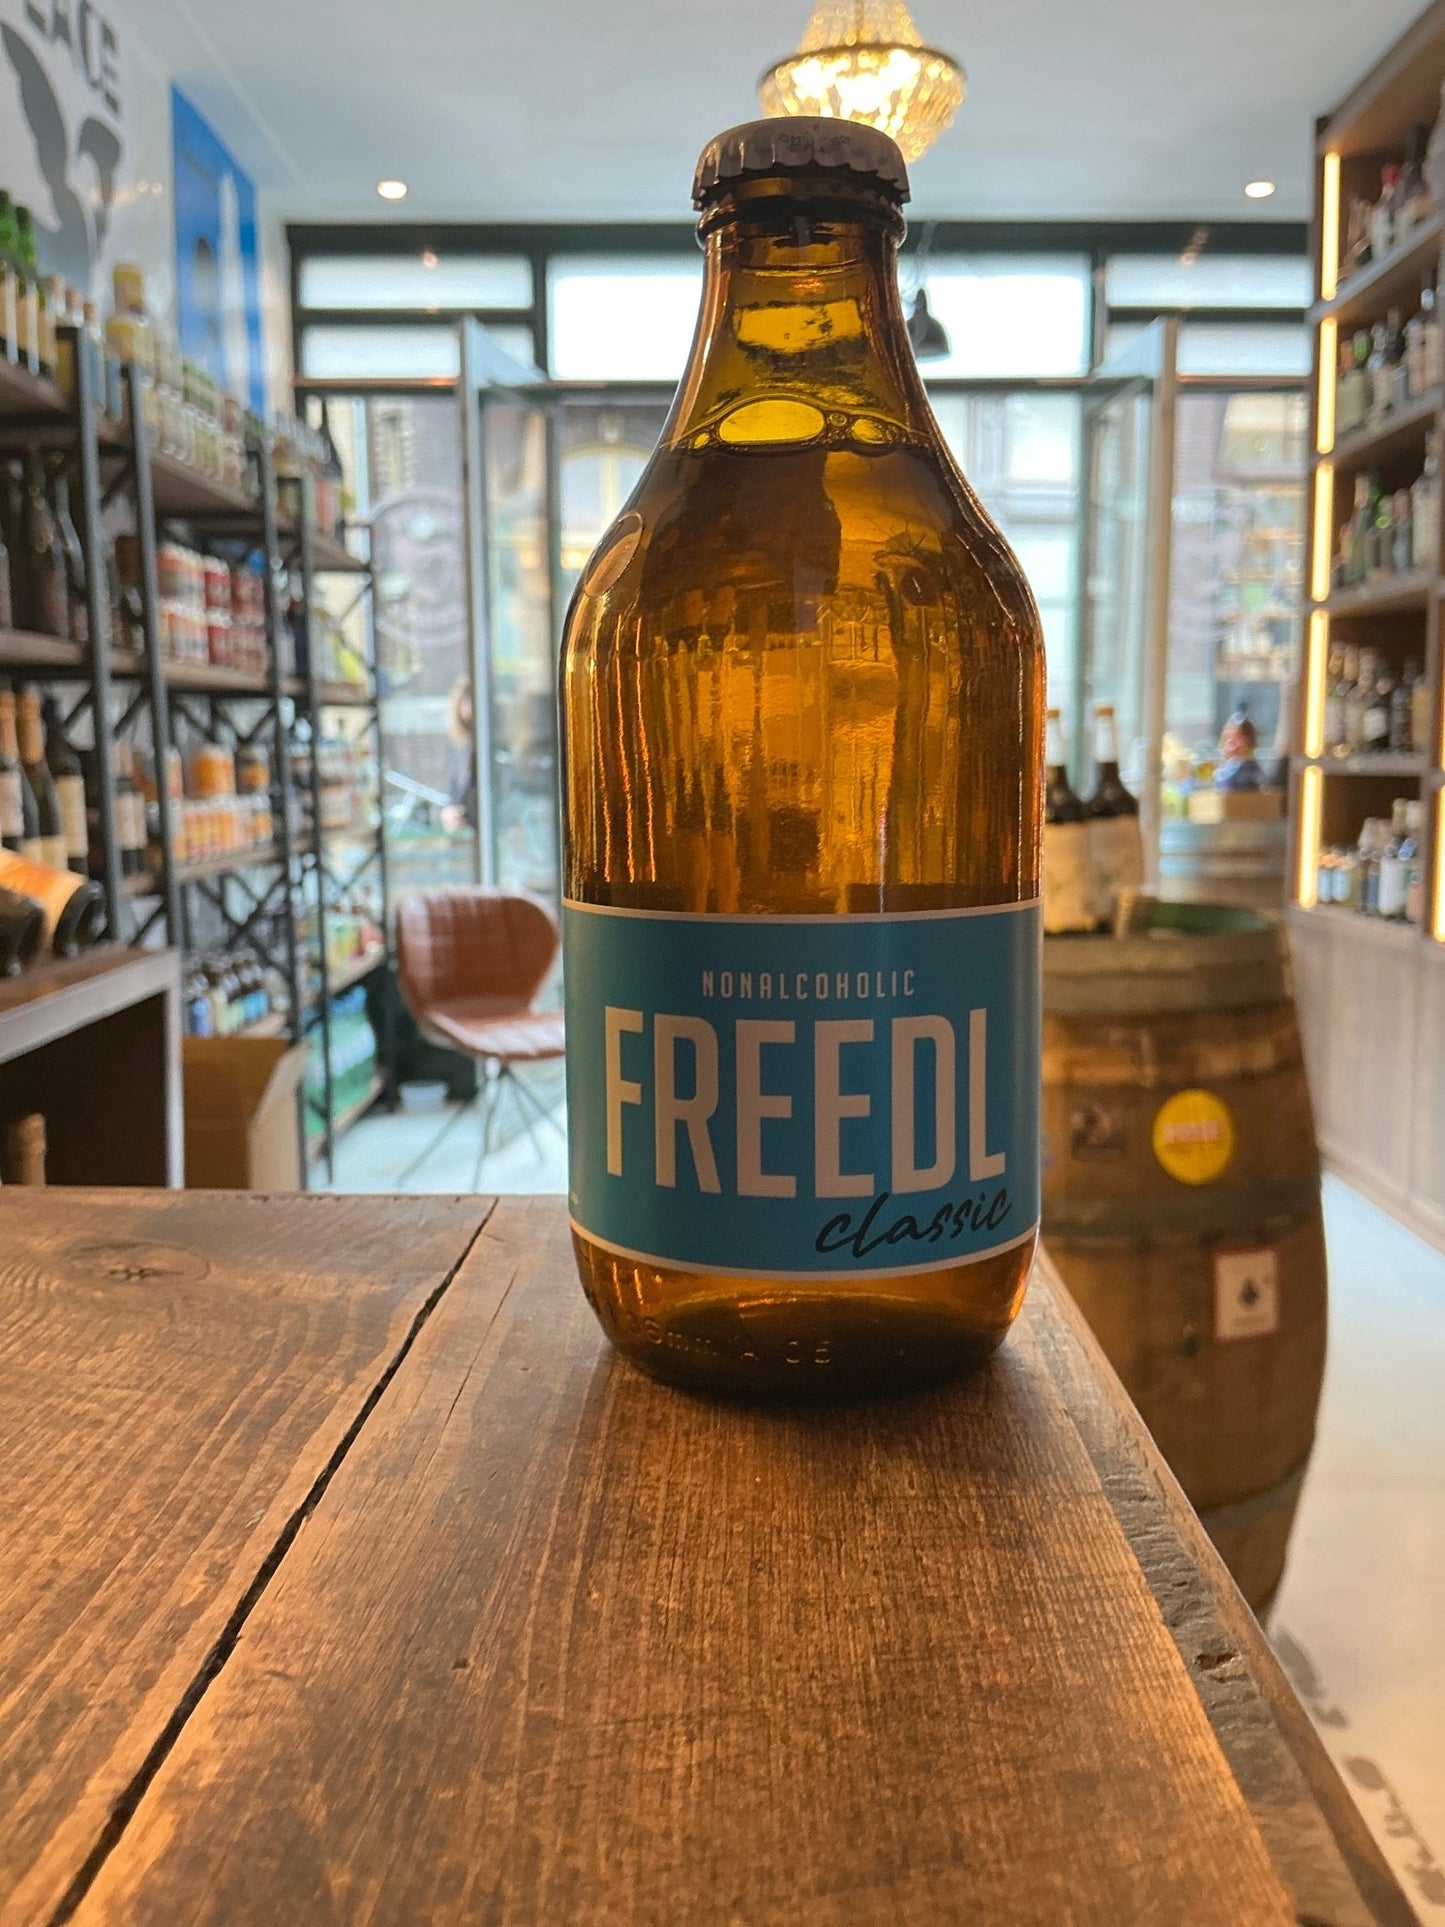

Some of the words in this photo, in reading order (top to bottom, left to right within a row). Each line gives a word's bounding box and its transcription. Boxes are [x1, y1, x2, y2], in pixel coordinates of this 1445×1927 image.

[702, 969, 915, 1000] NONALCOHOLIC
[605, 1005, 1006, 1199] FREEDL
[815, 1188, 1012, 1258] classic
